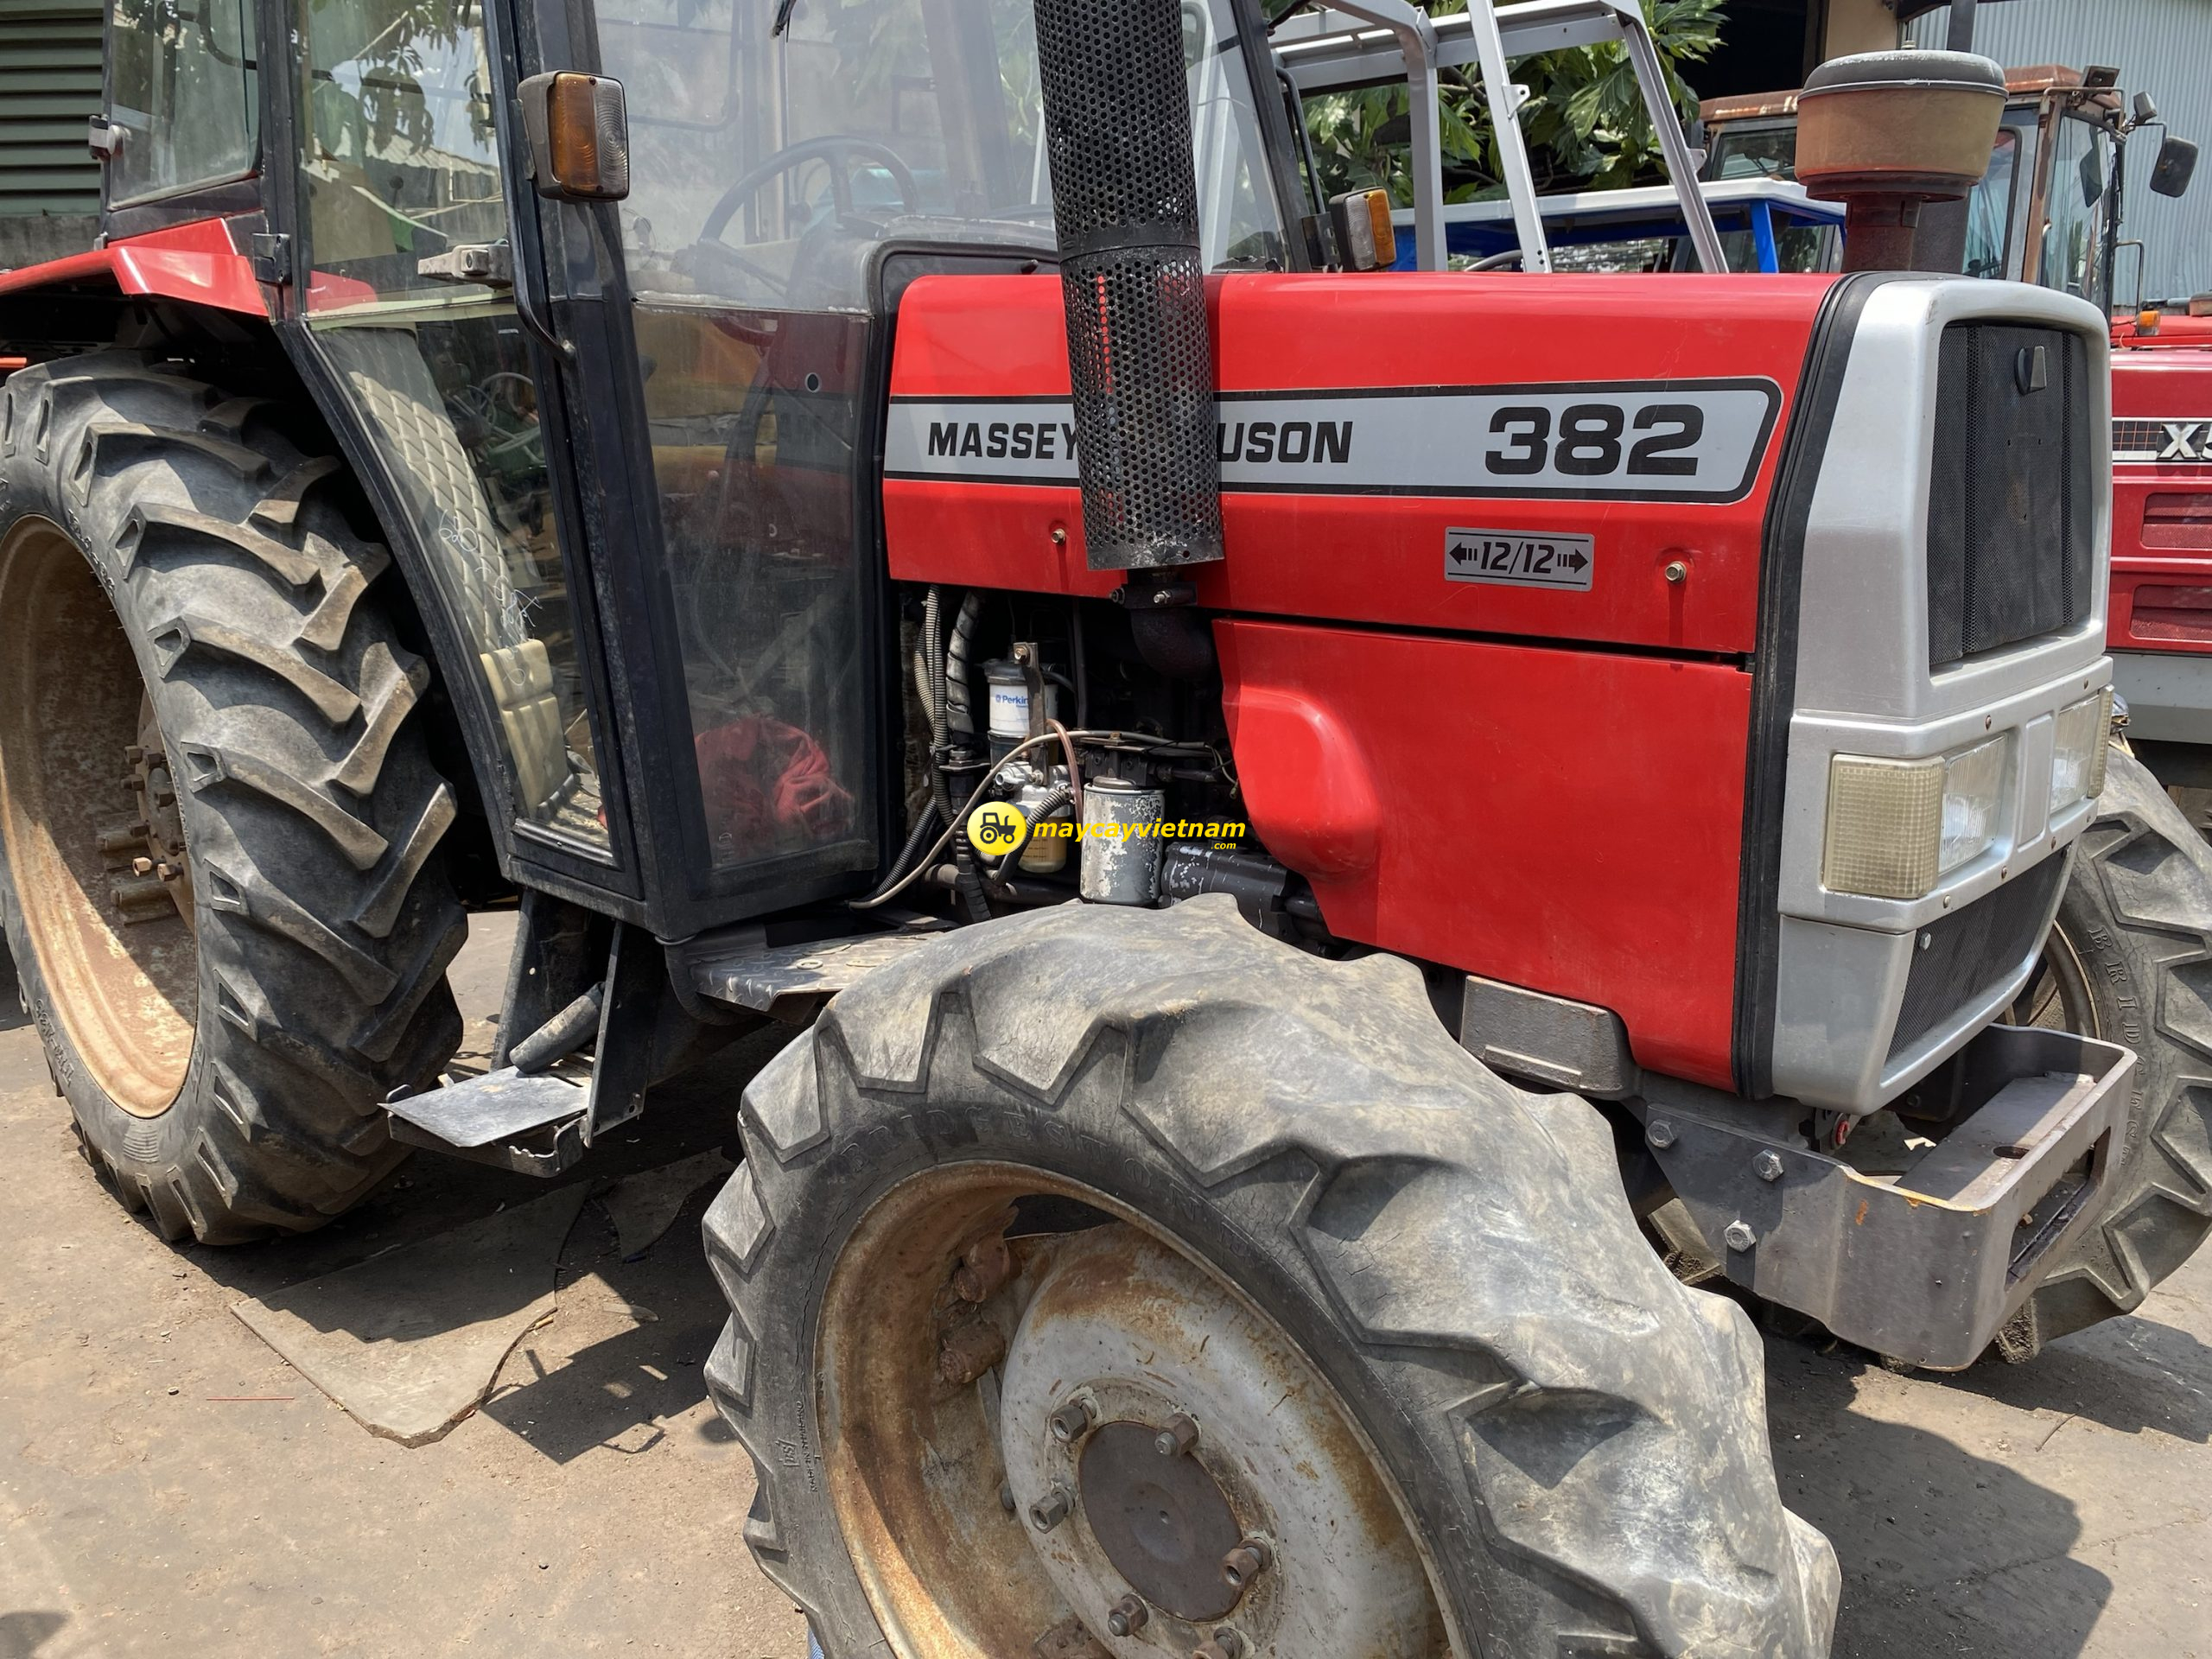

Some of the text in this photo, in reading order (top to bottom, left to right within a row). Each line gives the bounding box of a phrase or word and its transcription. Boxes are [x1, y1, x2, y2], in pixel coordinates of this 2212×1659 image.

[928, 421, 1353, 463] MASSEY USON
[1484, 403, 1705, 477] 382
[2158, 423, 2212, 459] X
[1480, 540, 1553, 576] 12/12
